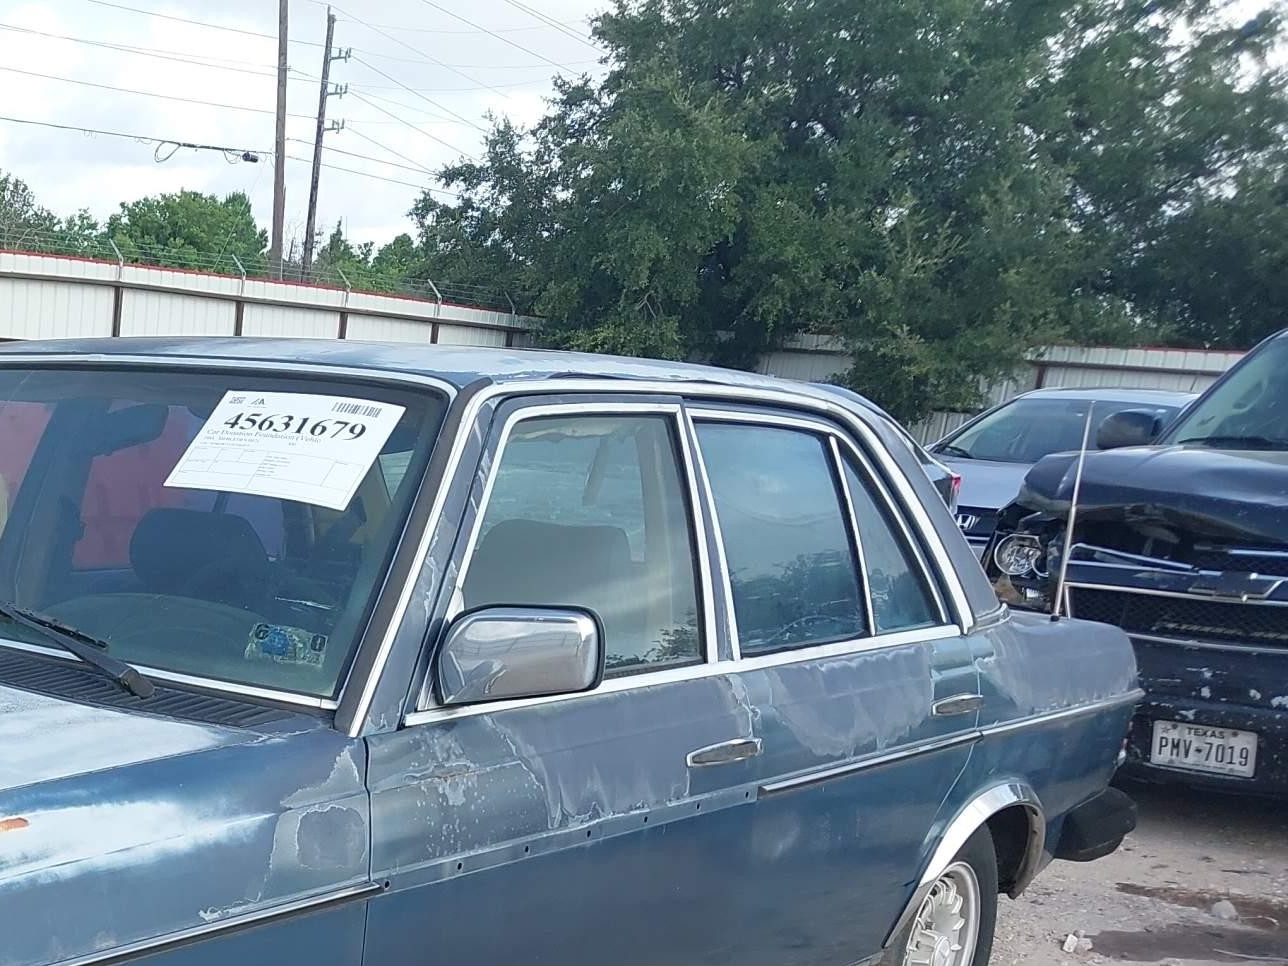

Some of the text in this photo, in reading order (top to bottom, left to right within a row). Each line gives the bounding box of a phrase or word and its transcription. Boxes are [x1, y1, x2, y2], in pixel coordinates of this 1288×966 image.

[224, 411, 367, 441] 45631679
[1186, 726, 1225, 740] TEXAS
[1158, 736, 1249, 767] PMV-7019
